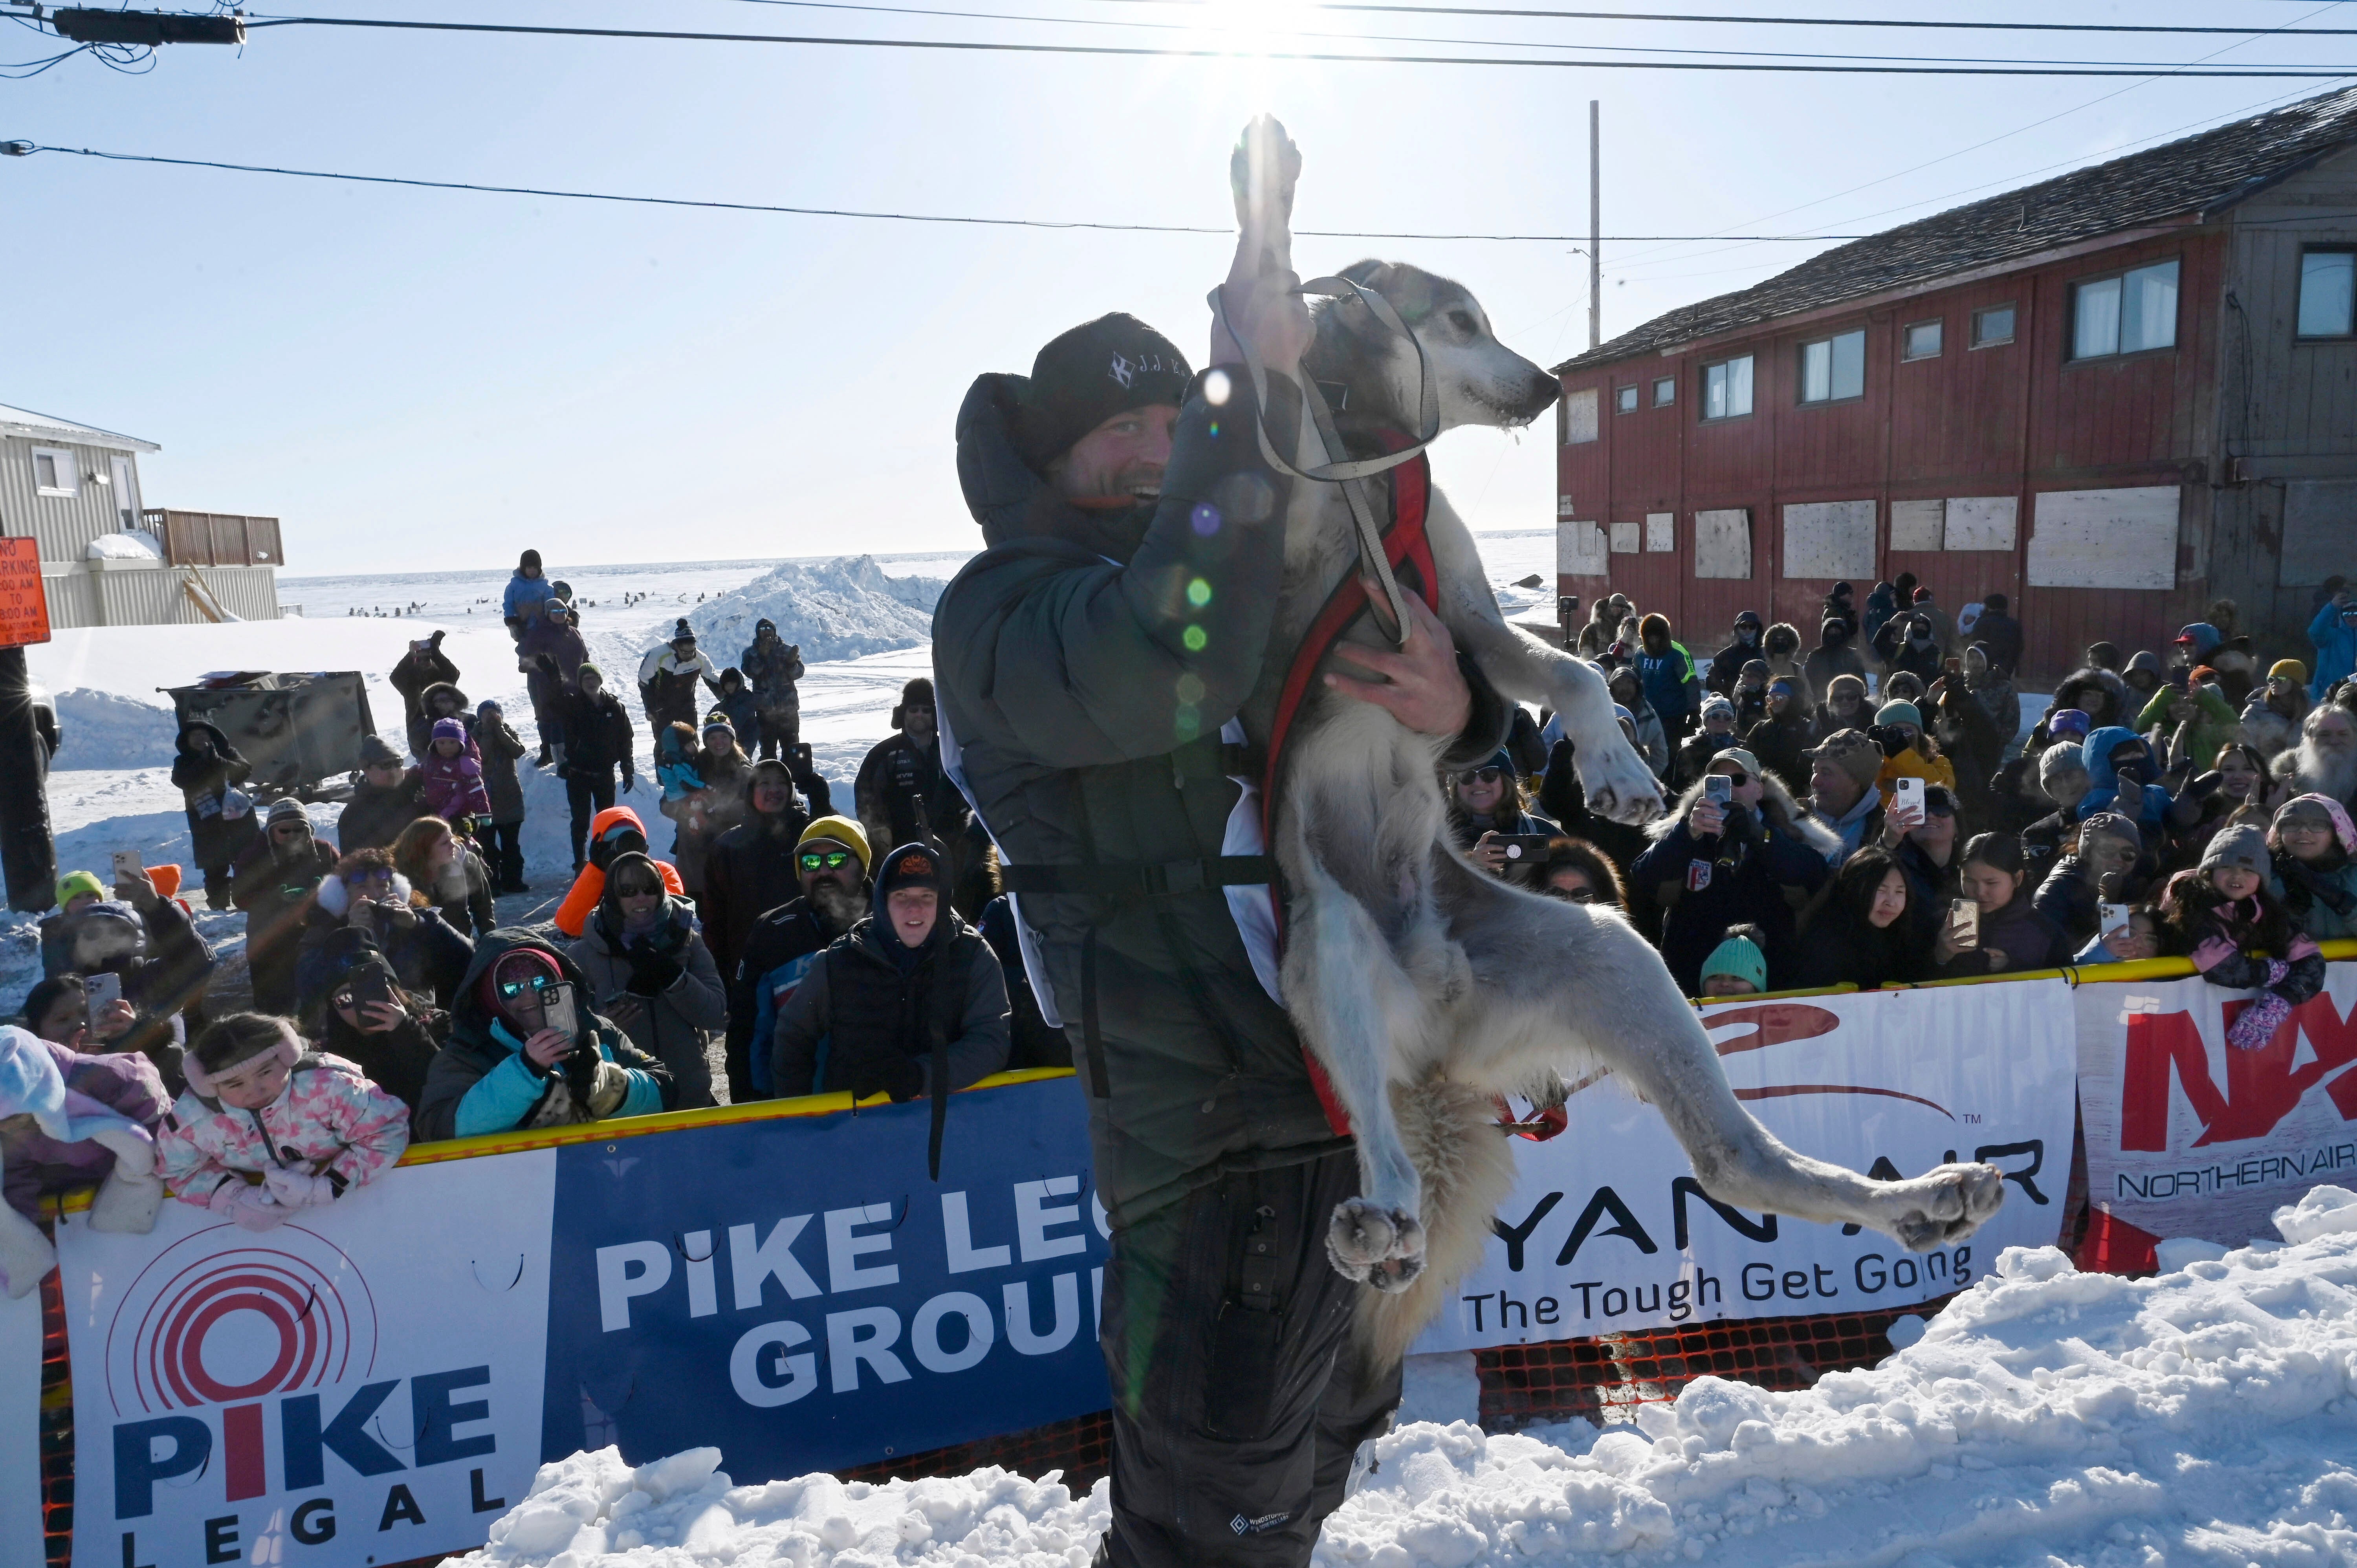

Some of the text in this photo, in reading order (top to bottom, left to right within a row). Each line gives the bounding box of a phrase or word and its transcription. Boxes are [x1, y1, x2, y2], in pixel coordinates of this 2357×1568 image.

[0, 559, 36, 577] RKING
[20, 579, 34, 590] AM
[10, 593, 22, 605] TO
[24, 606, 38, 617] AM
[1643, 658, 1663, 670] FLY
[1963, 1114, 1981, 1123] TM
[2119, 1143, 2355, 1198] NORTHERN AIR
[941, 1175, 1112, 1274] LE
[1462, 1246, 1971, 1332] The Tough Get Going
[729, 1266, 1103, 1408] GROU
[121, 1468, 505, 1568] LEGAL
